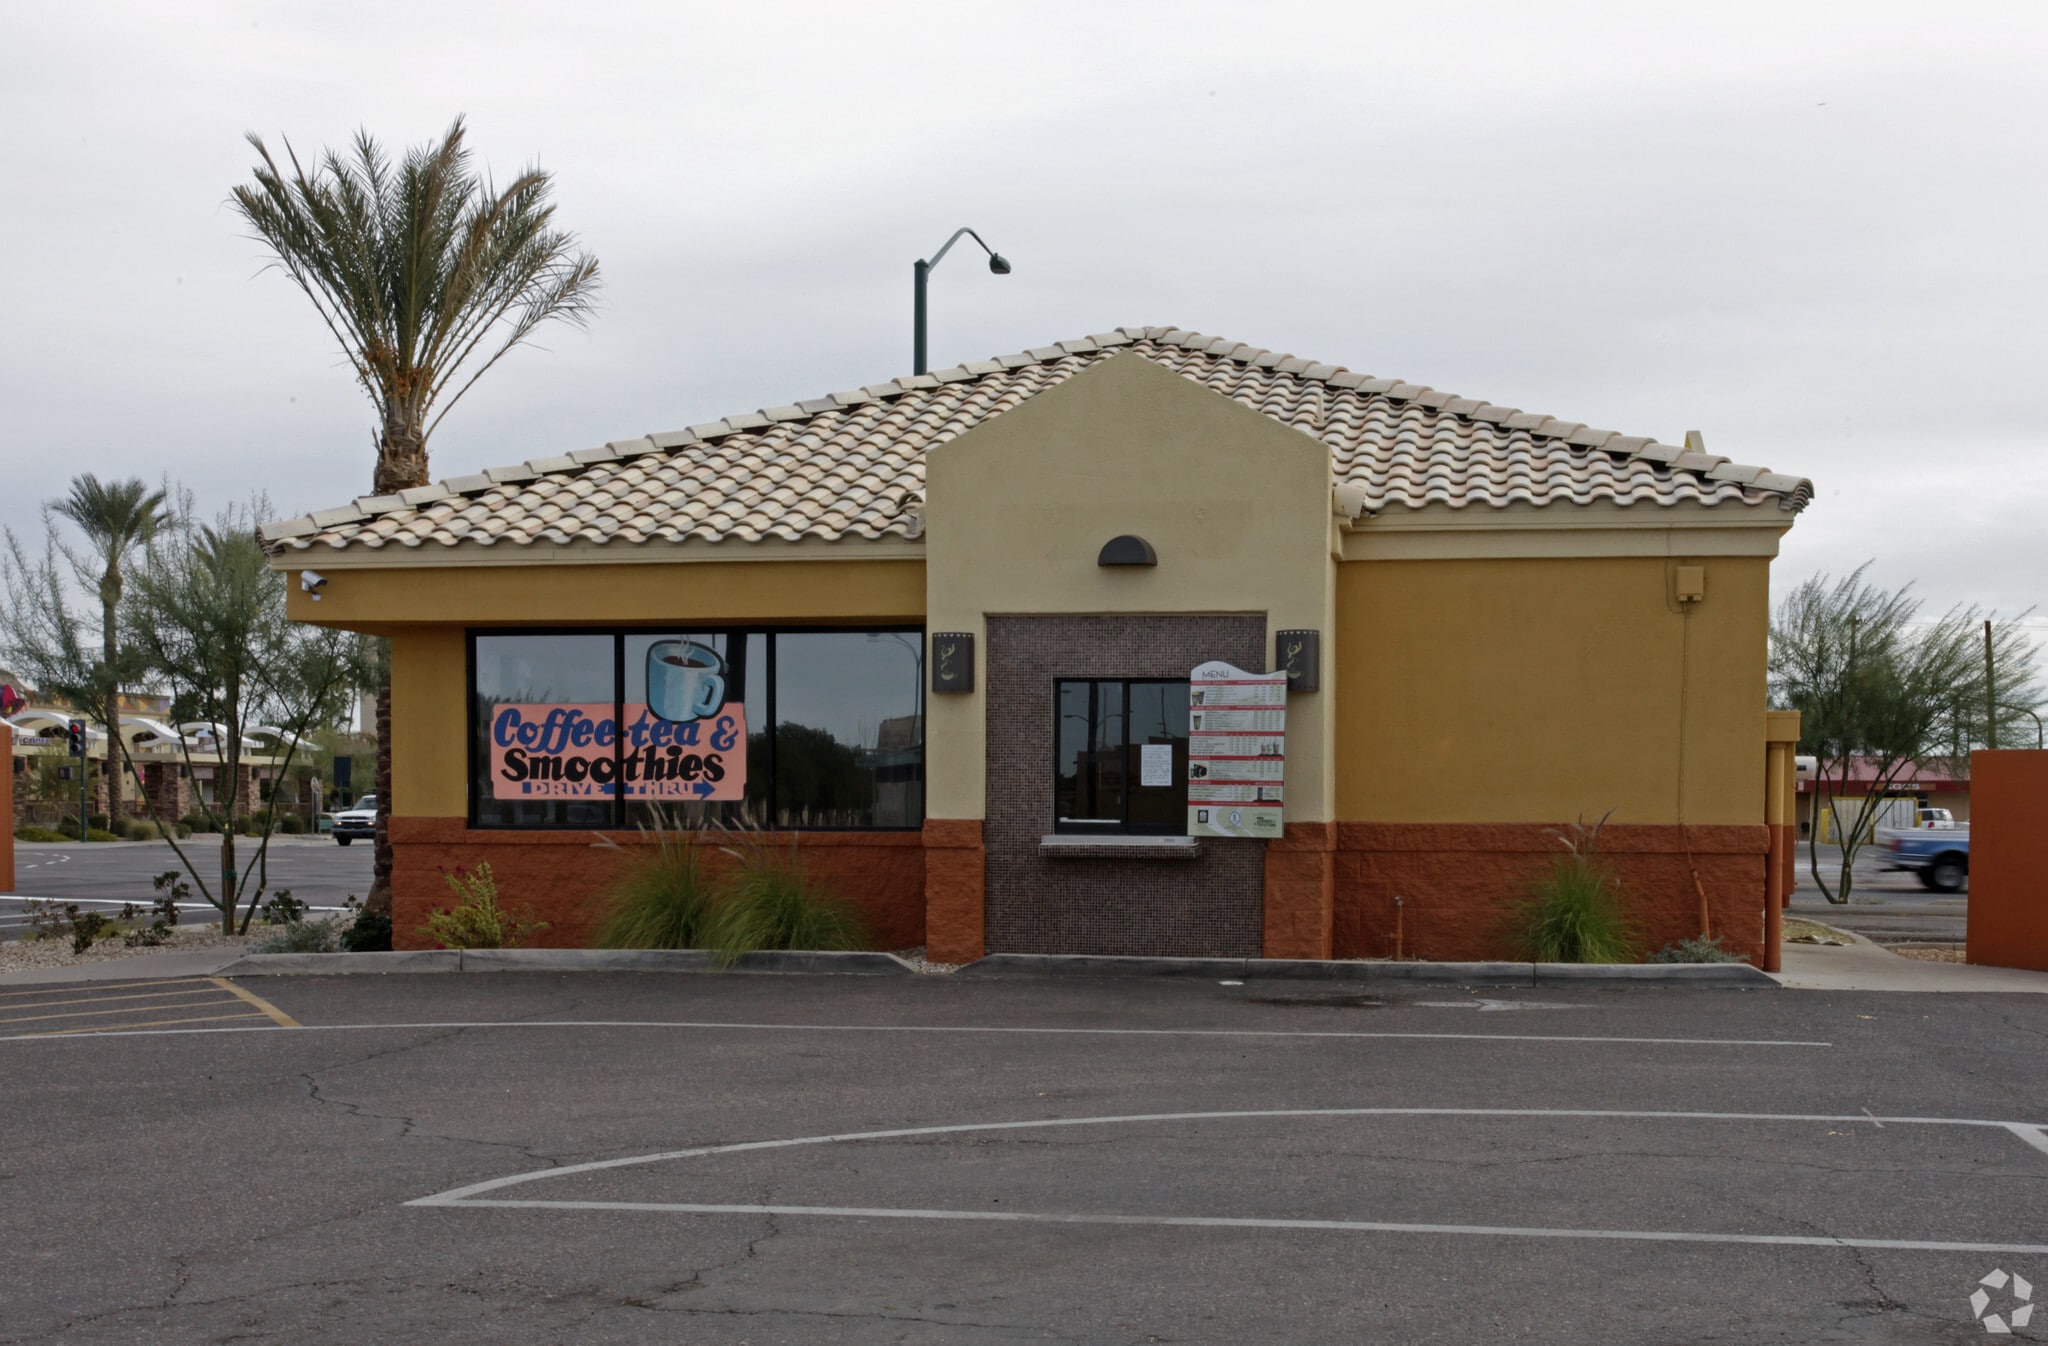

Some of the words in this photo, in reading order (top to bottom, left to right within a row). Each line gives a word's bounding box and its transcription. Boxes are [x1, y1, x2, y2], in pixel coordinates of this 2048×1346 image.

[1202, 671, 1229, 679] MENU
[710, 716, 739, 751] &
[501, 745, 725, 784] Smoothies
[533, 782, 604, 796] DRIVE
[631, 782, 694, 796] THRU
